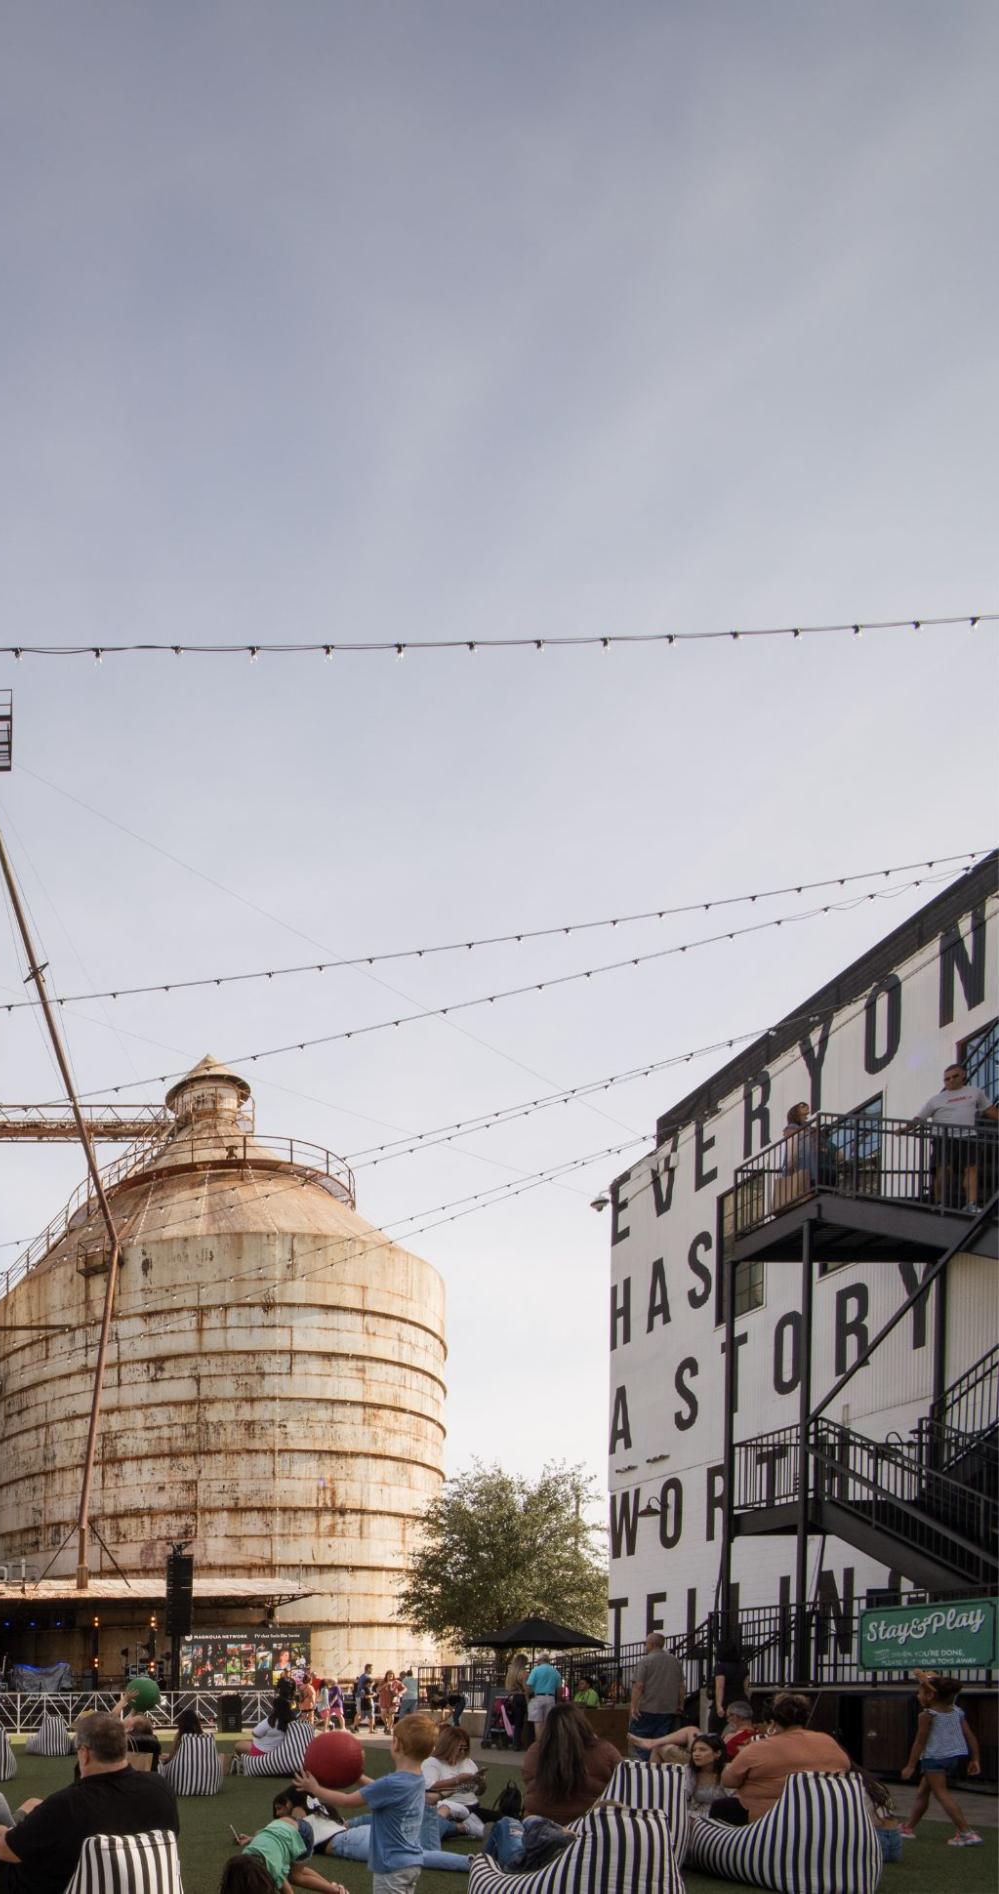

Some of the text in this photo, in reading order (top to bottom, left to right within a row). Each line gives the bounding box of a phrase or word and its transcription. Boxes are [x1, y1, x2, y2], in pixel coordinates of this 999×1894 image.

[610, 1231, 712, 1352] HAS
[609, 1262, 934, 1456] A STORY
[608, 1567, 926, 1672] TELLIN
